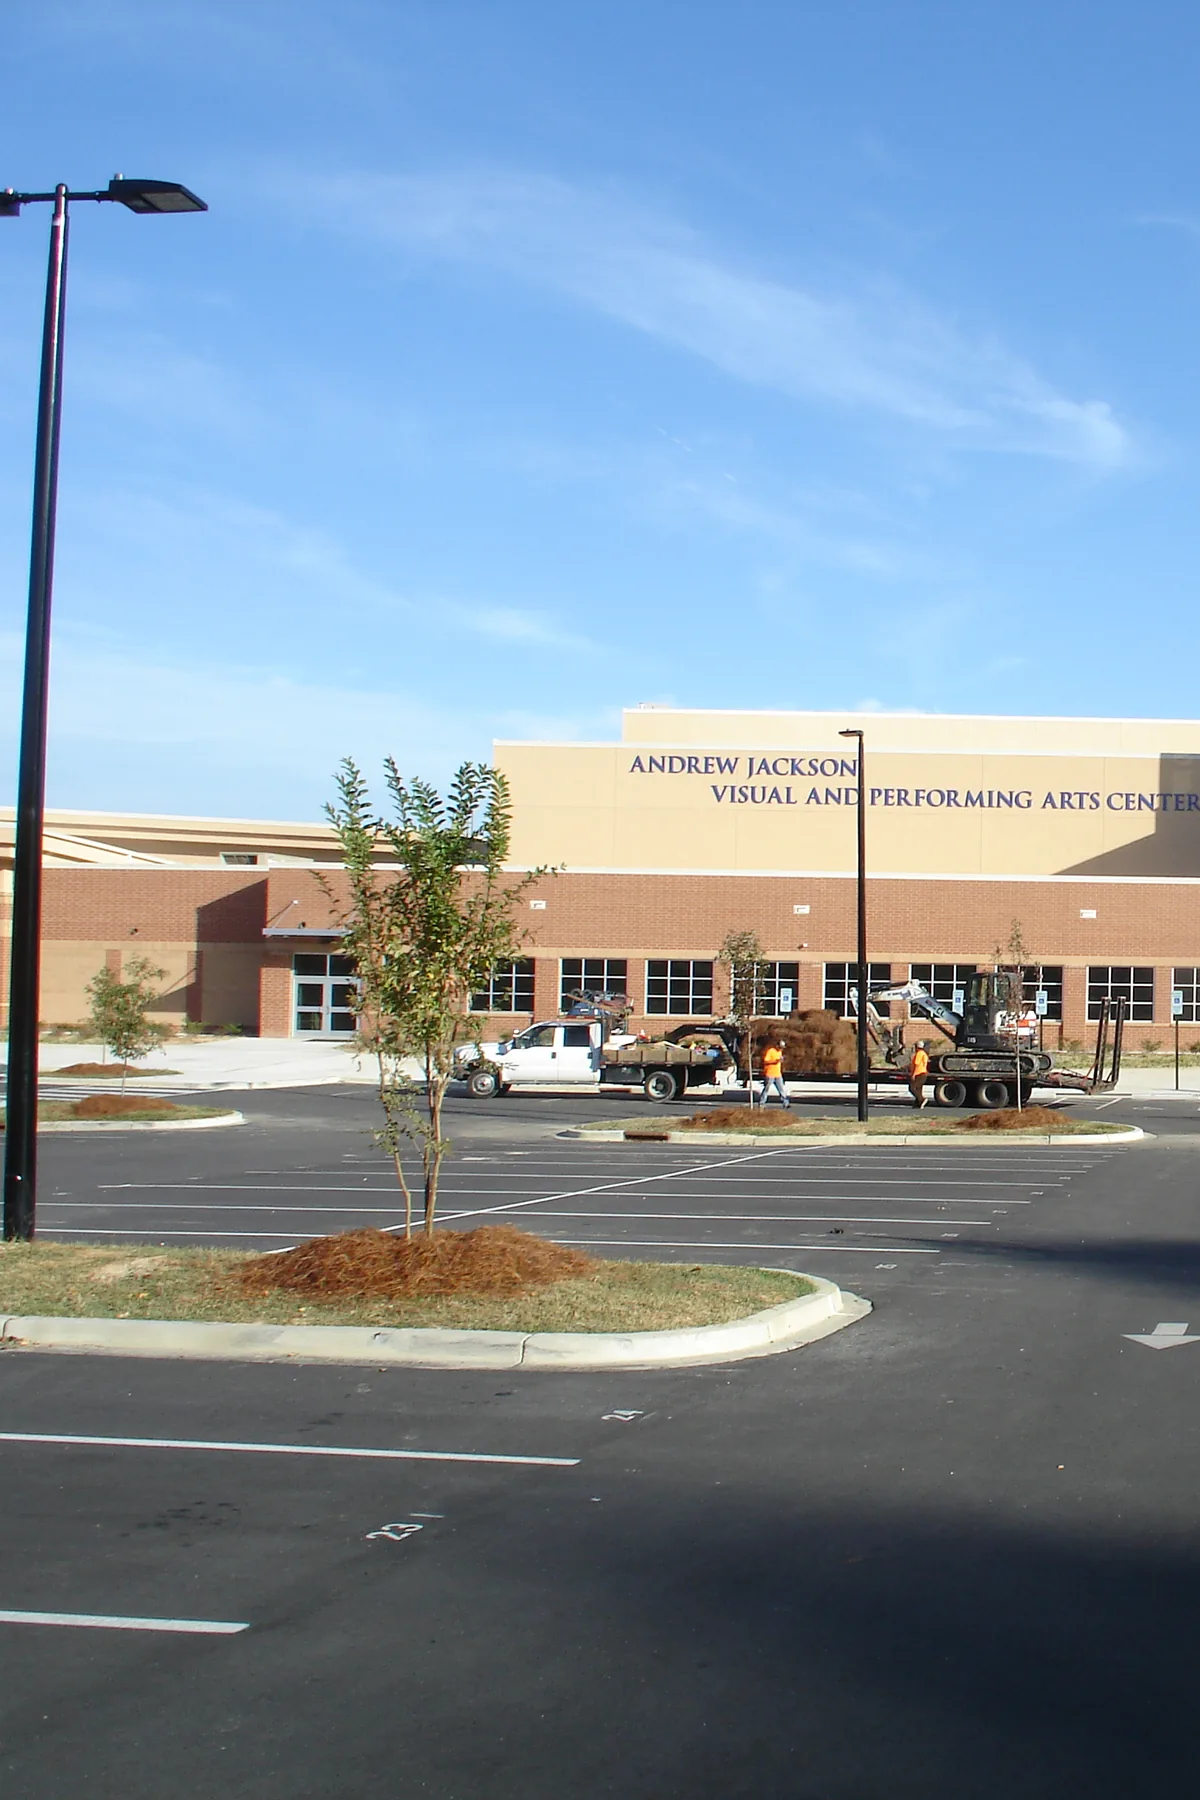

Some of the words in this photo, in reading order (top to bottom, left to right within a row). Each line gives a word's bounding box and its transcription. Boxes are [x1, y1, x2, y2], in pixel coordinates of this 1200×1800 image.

[629, 755, 738, 774] ANDREW
[747, 757, 858, 779] JACKSON
[711, 785, 797, 804] VISUAL
[804, 787, 859, 805] AND
[869, 788, 1032, 809] PERFORMING
[1041, 791, 1100, 810] ARTS
[366, 1523, 424, 1541] 23
